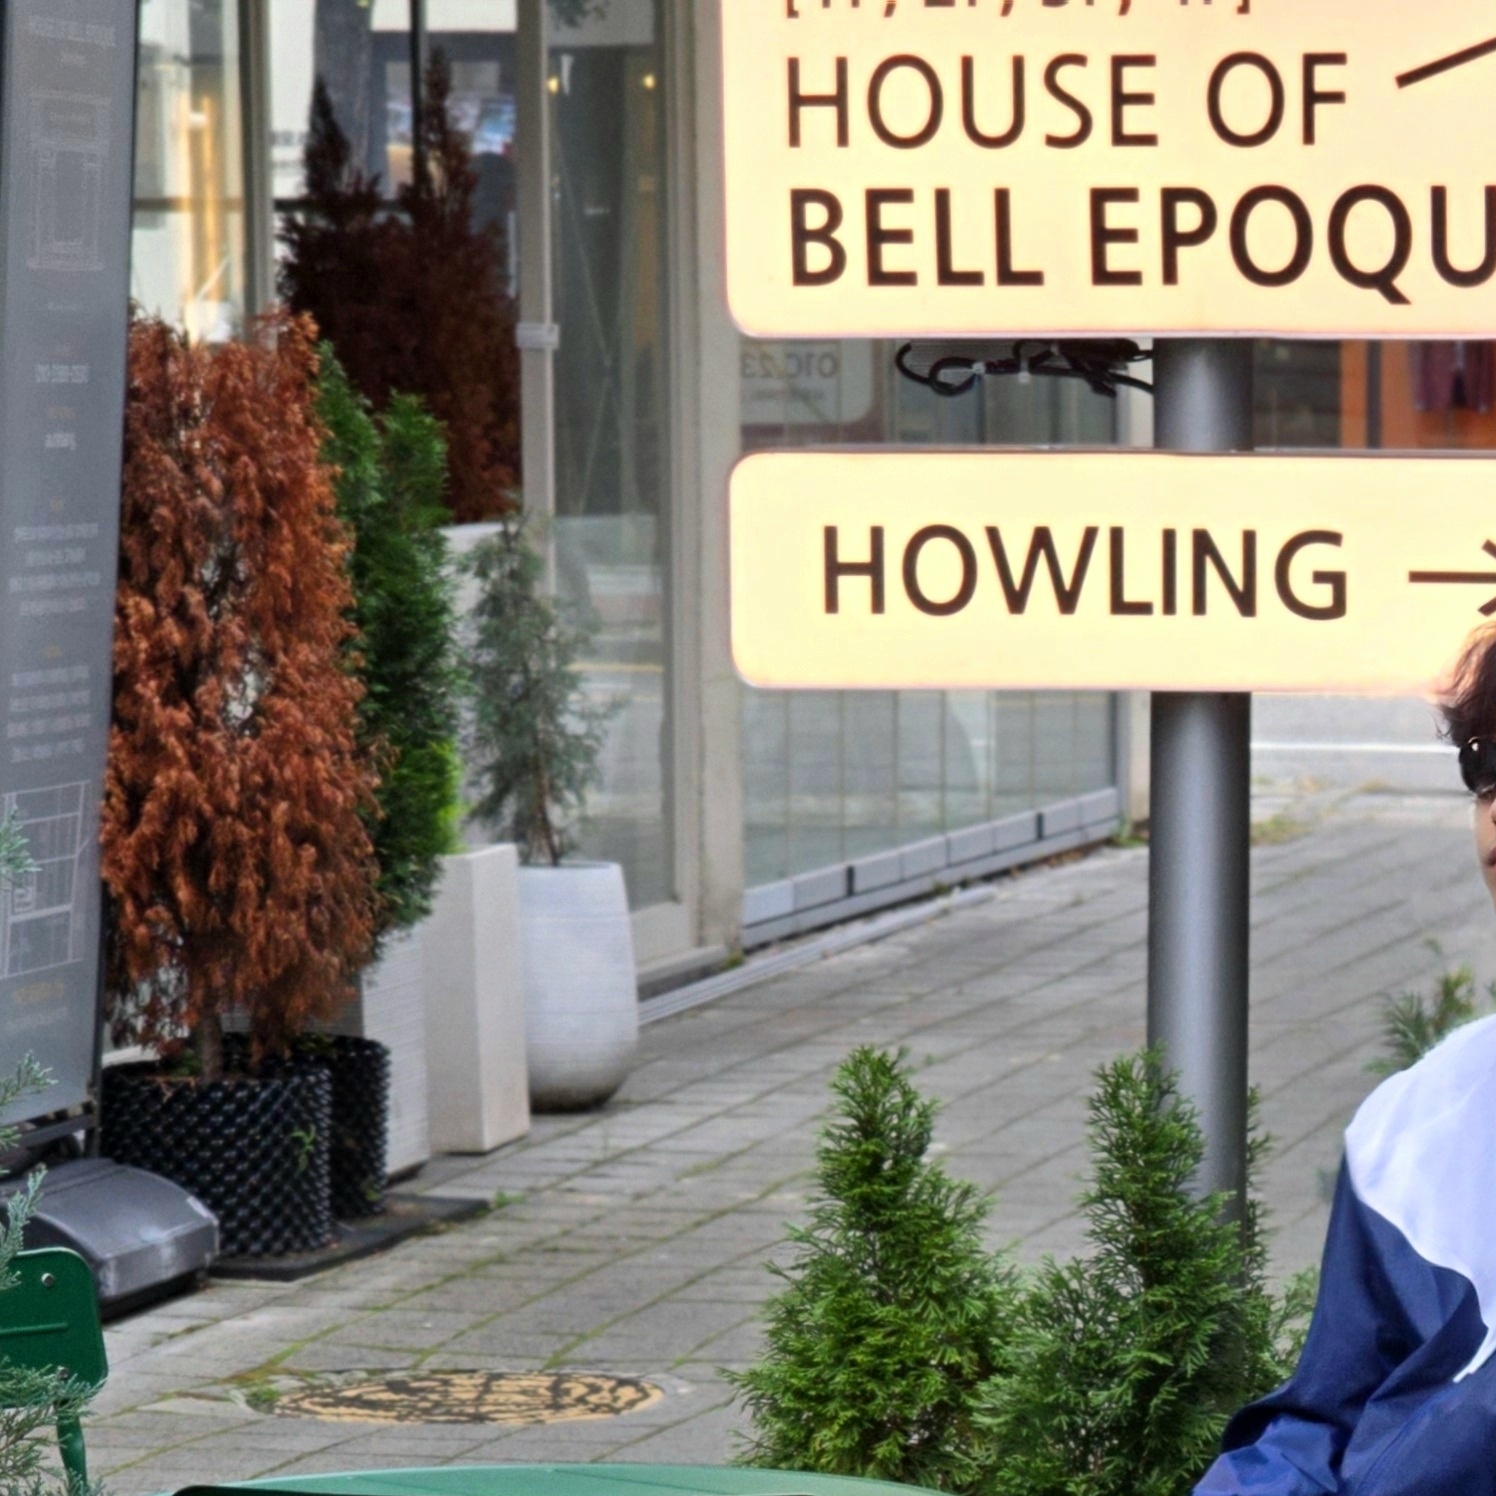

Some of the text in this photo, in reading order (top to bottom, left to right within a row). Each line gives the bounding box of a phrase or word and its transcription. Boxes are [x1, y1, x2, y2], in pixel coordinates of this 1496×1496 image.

[786, 50, 1349, 150] HOUSE OF
[789, 186, 1045, 288] BELL
[823, 523, 1348, 622] HOWLING
